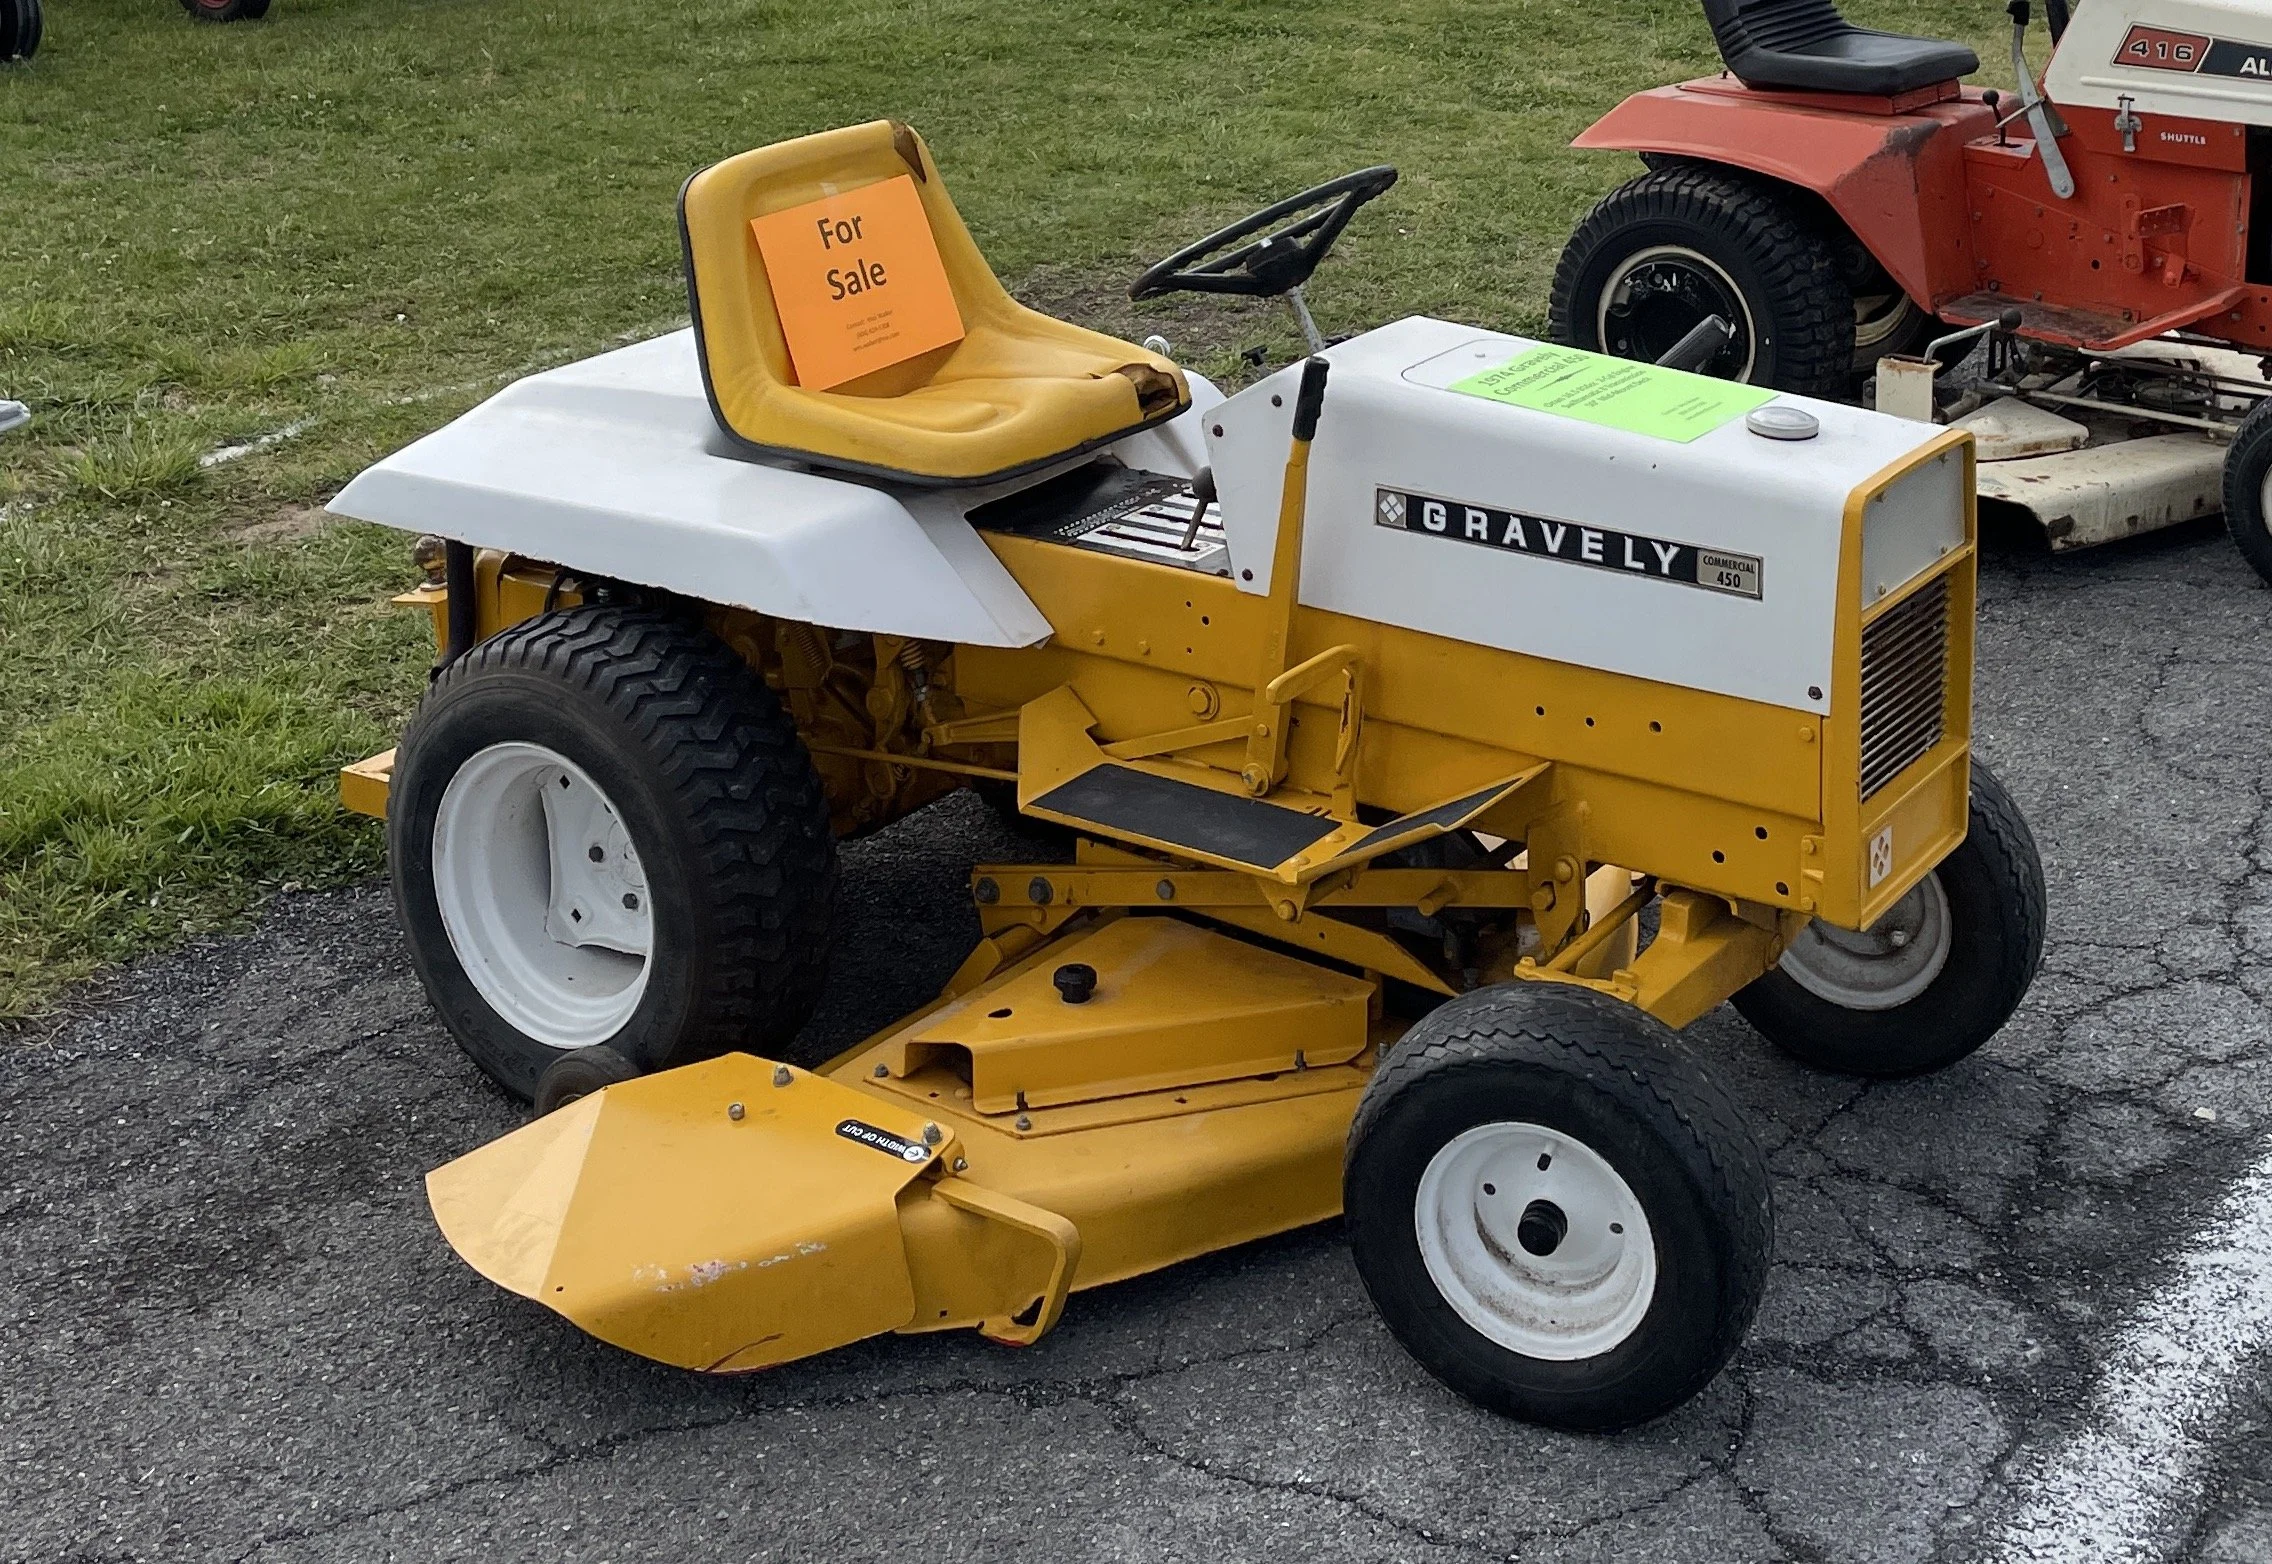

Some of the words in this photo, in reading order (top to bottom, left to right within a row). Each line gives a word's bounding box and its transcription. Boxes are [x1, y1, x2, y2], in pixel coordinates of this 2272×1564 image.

[2129, 39, 2194, 63] 416
[2240, 56, 2272, 76] AL
[2160, 132, 2206, 145] SHUTTLE
[817, 215, 863, 250] For
[826, 258, 887, 301] Sale
[1478, 370, 1516, 386] 1974
[1508, 351, 1561, 373] Gravely
[1493, 361, 1568, 396] Commercial
[1422, 501, 1680, 575] GRAVELY
[1702, 554, 1755, 575] COMMERCIAL
[1716, 571, 1741, 590] 450
[841, 1124, 864, 1137] CUT
[861, 1132, 878, 1142] OF
[876, 1137, 907, 1154] WIDTH
